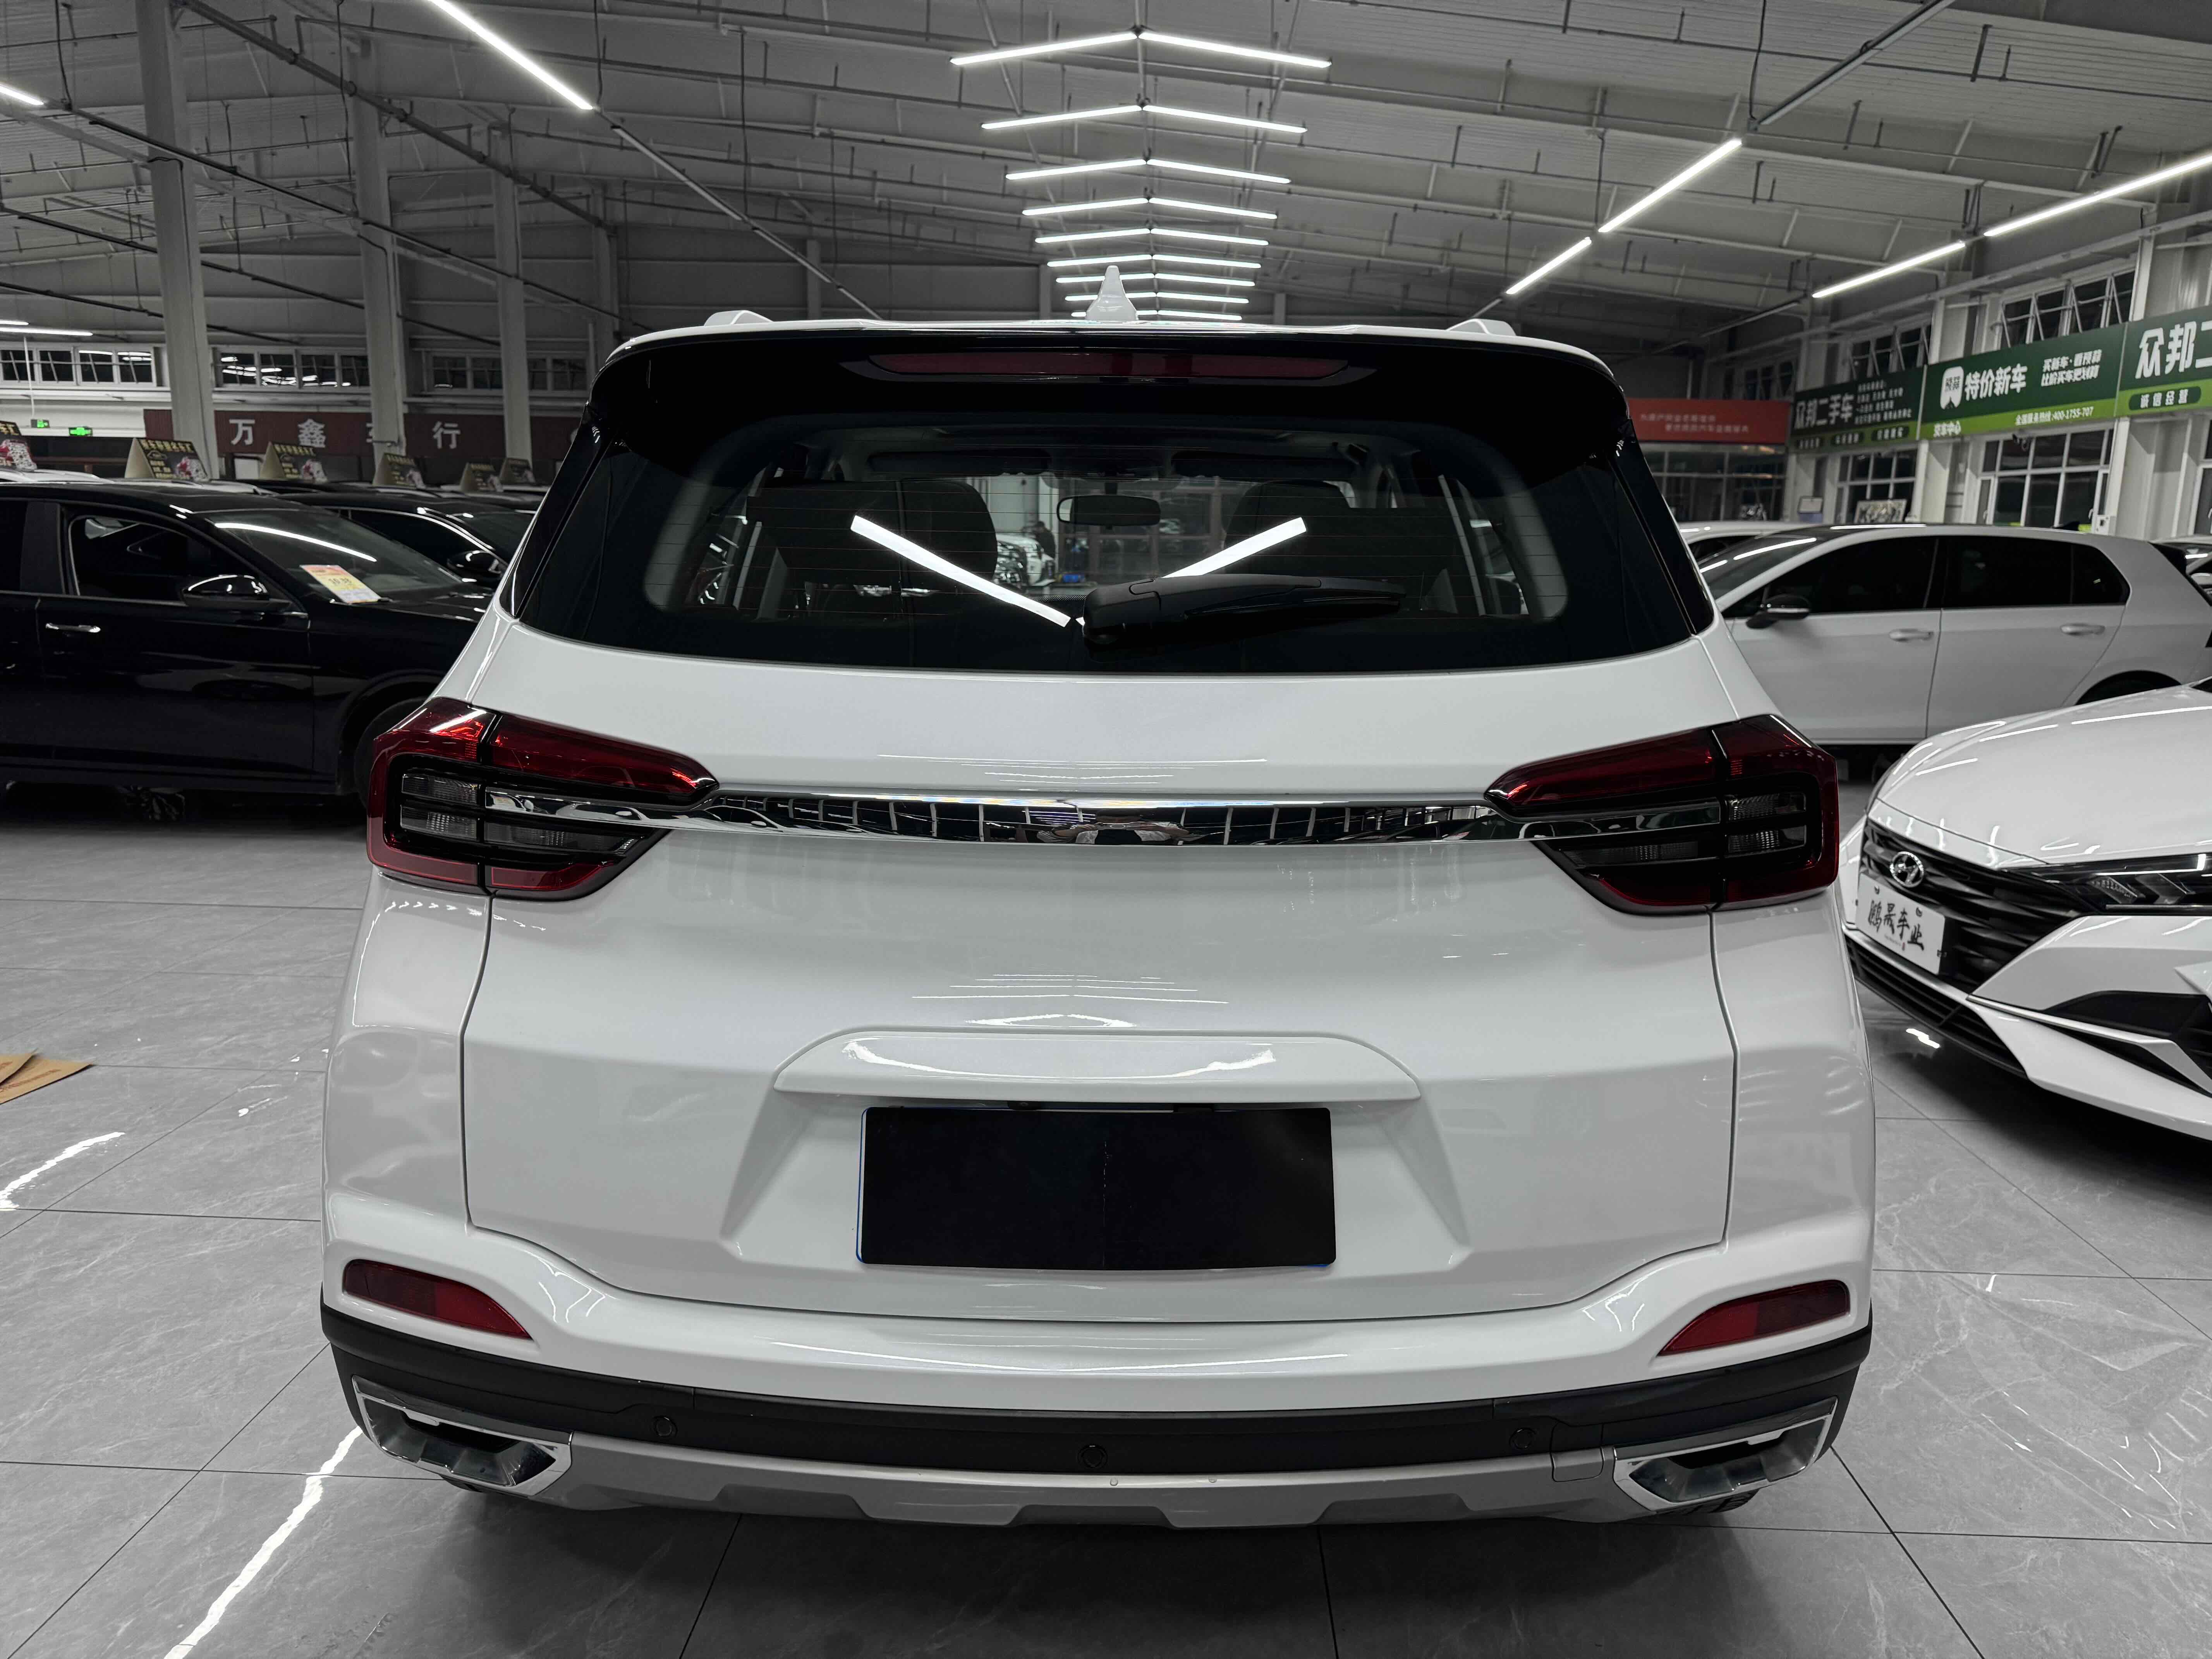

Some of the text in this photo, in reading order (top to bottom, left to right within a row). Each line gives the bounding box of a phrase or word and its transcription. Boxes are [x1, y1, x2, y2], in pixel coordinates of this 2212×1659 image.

[1965, 363, 2028, 401] 特价新车
[2140, 389, 2188, 409] 诚信经营
[1795, 393, 1854, 430] 众邦二手车
